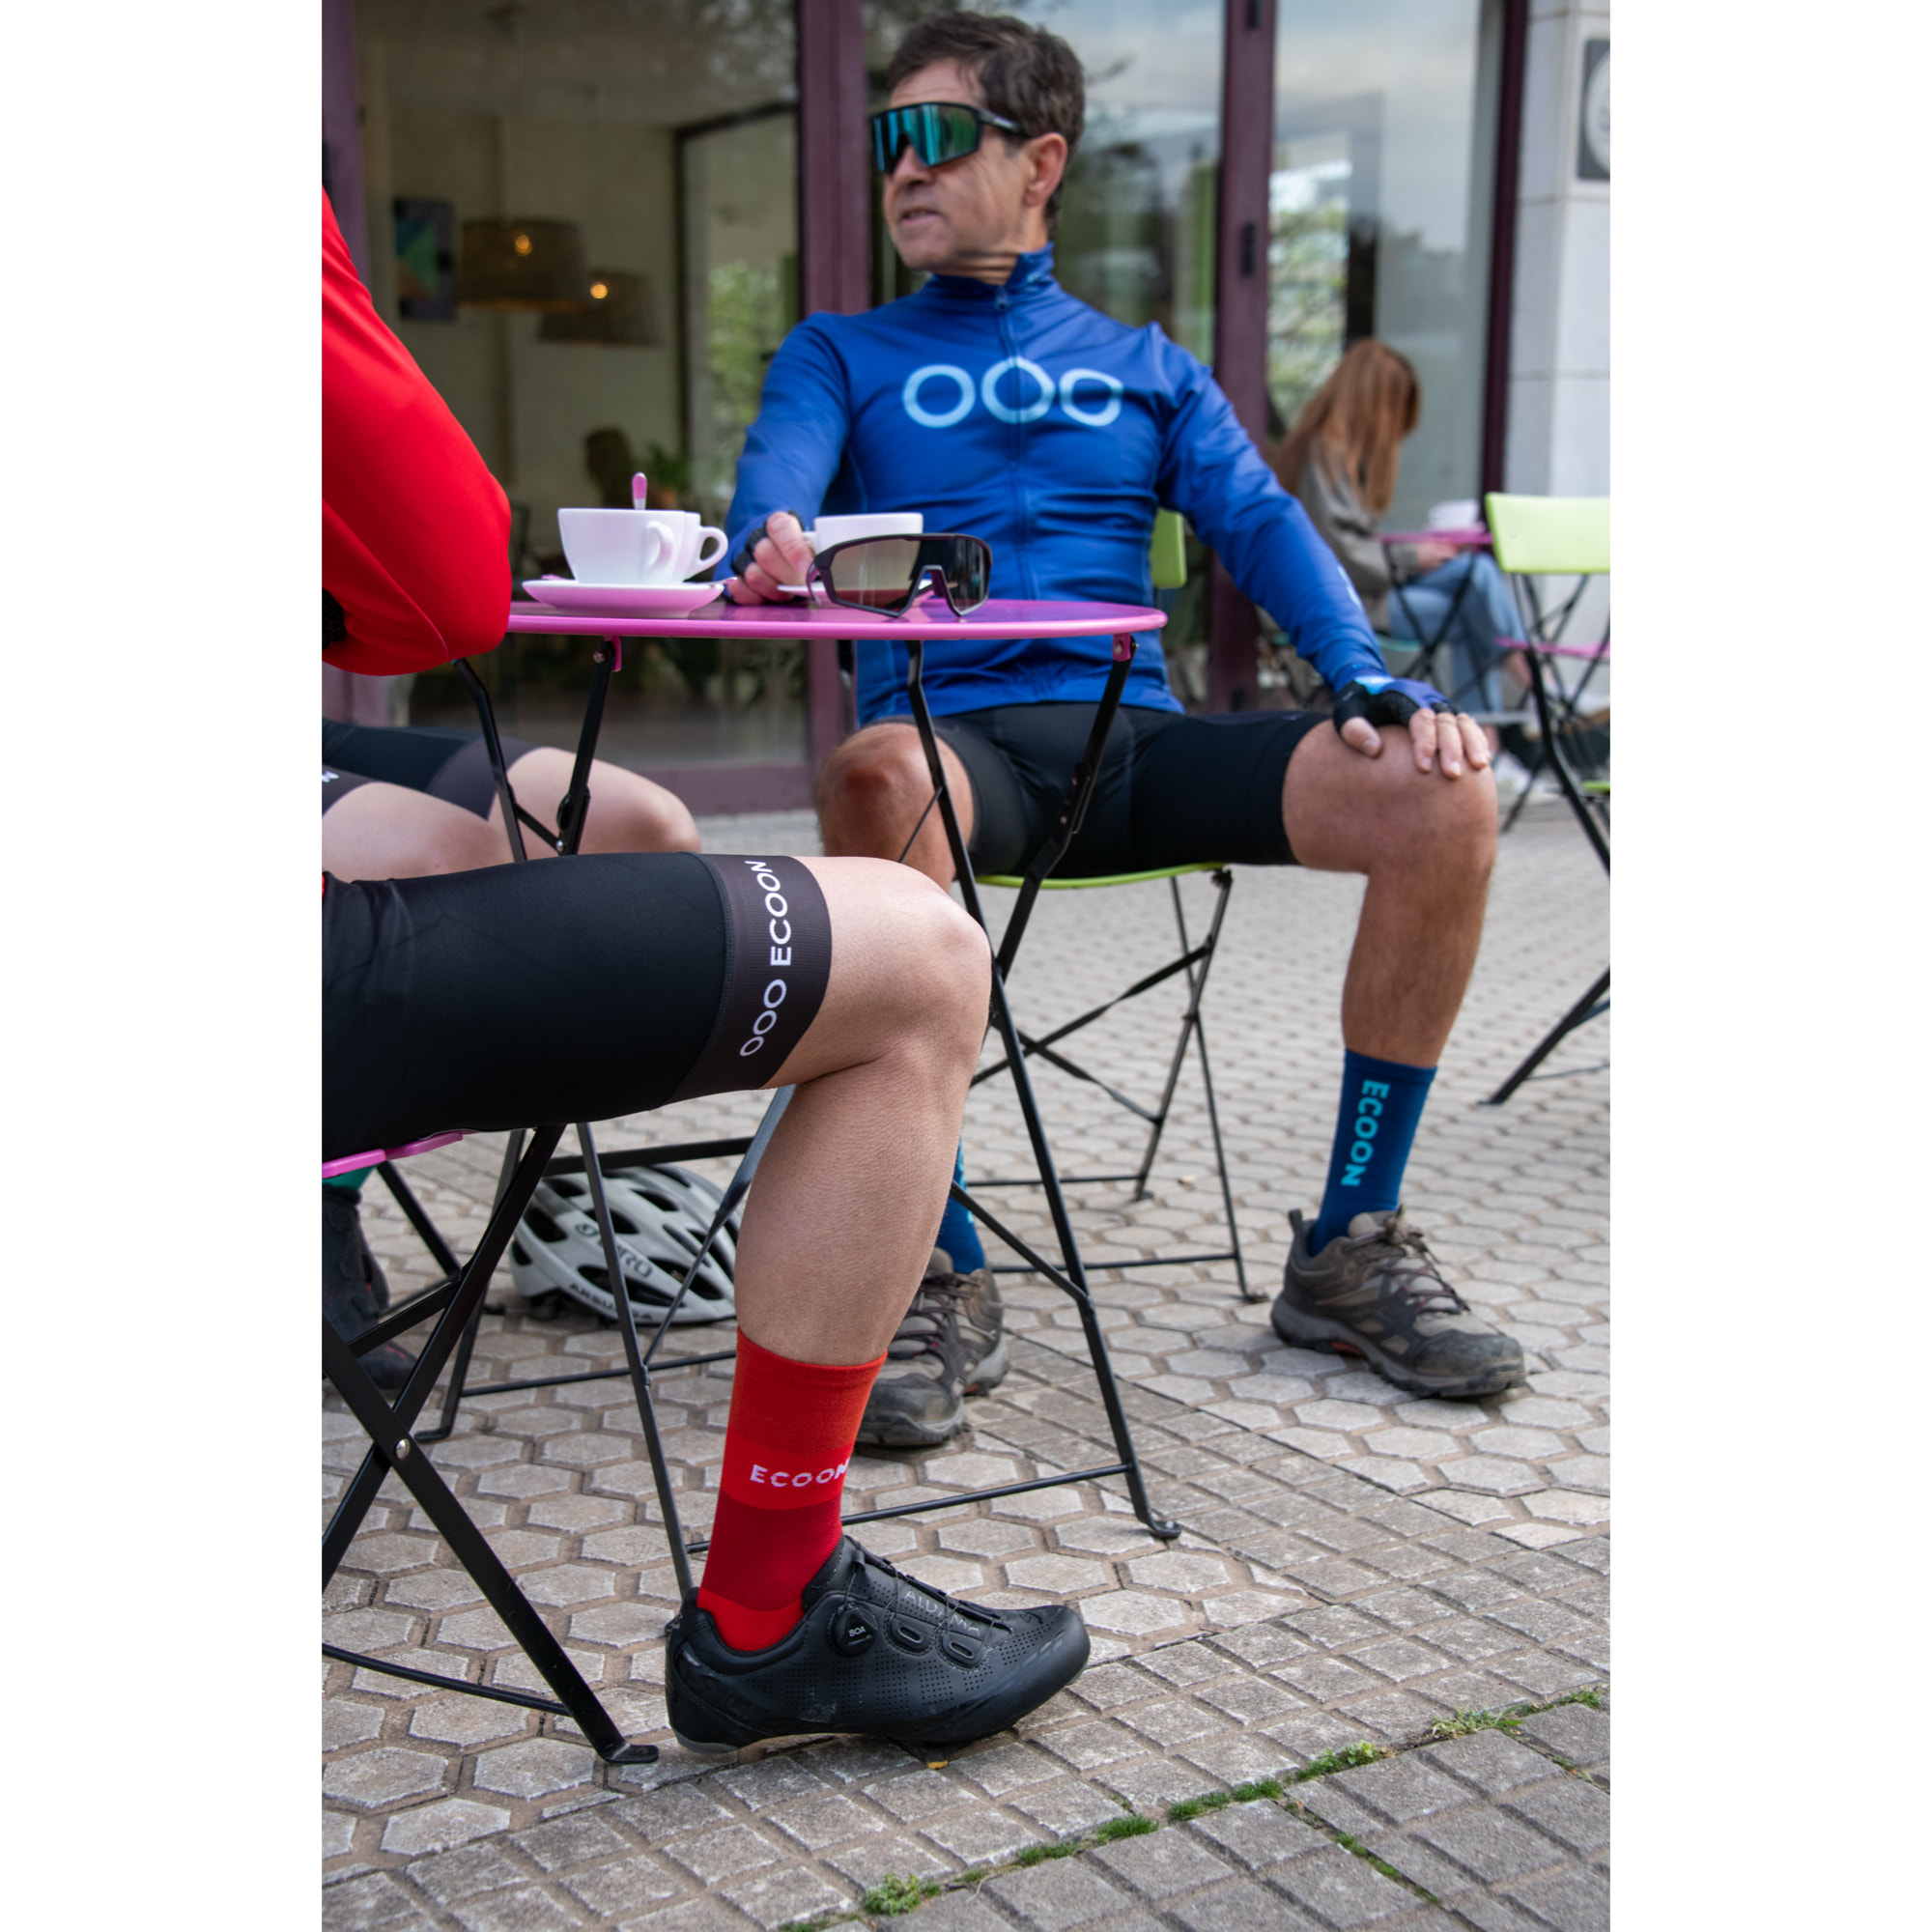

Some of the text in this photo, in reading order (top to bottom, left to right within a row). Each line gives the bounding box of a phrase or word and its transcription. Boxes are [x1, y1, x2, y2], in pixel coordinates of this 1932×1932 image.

[744, 860, 792, 966] ECOON
[1340, 1079, 1390, 1186] ECOON
[750, 1456, 850, 1488] ECOON
[848, 1625, 867, 1637] BOA
